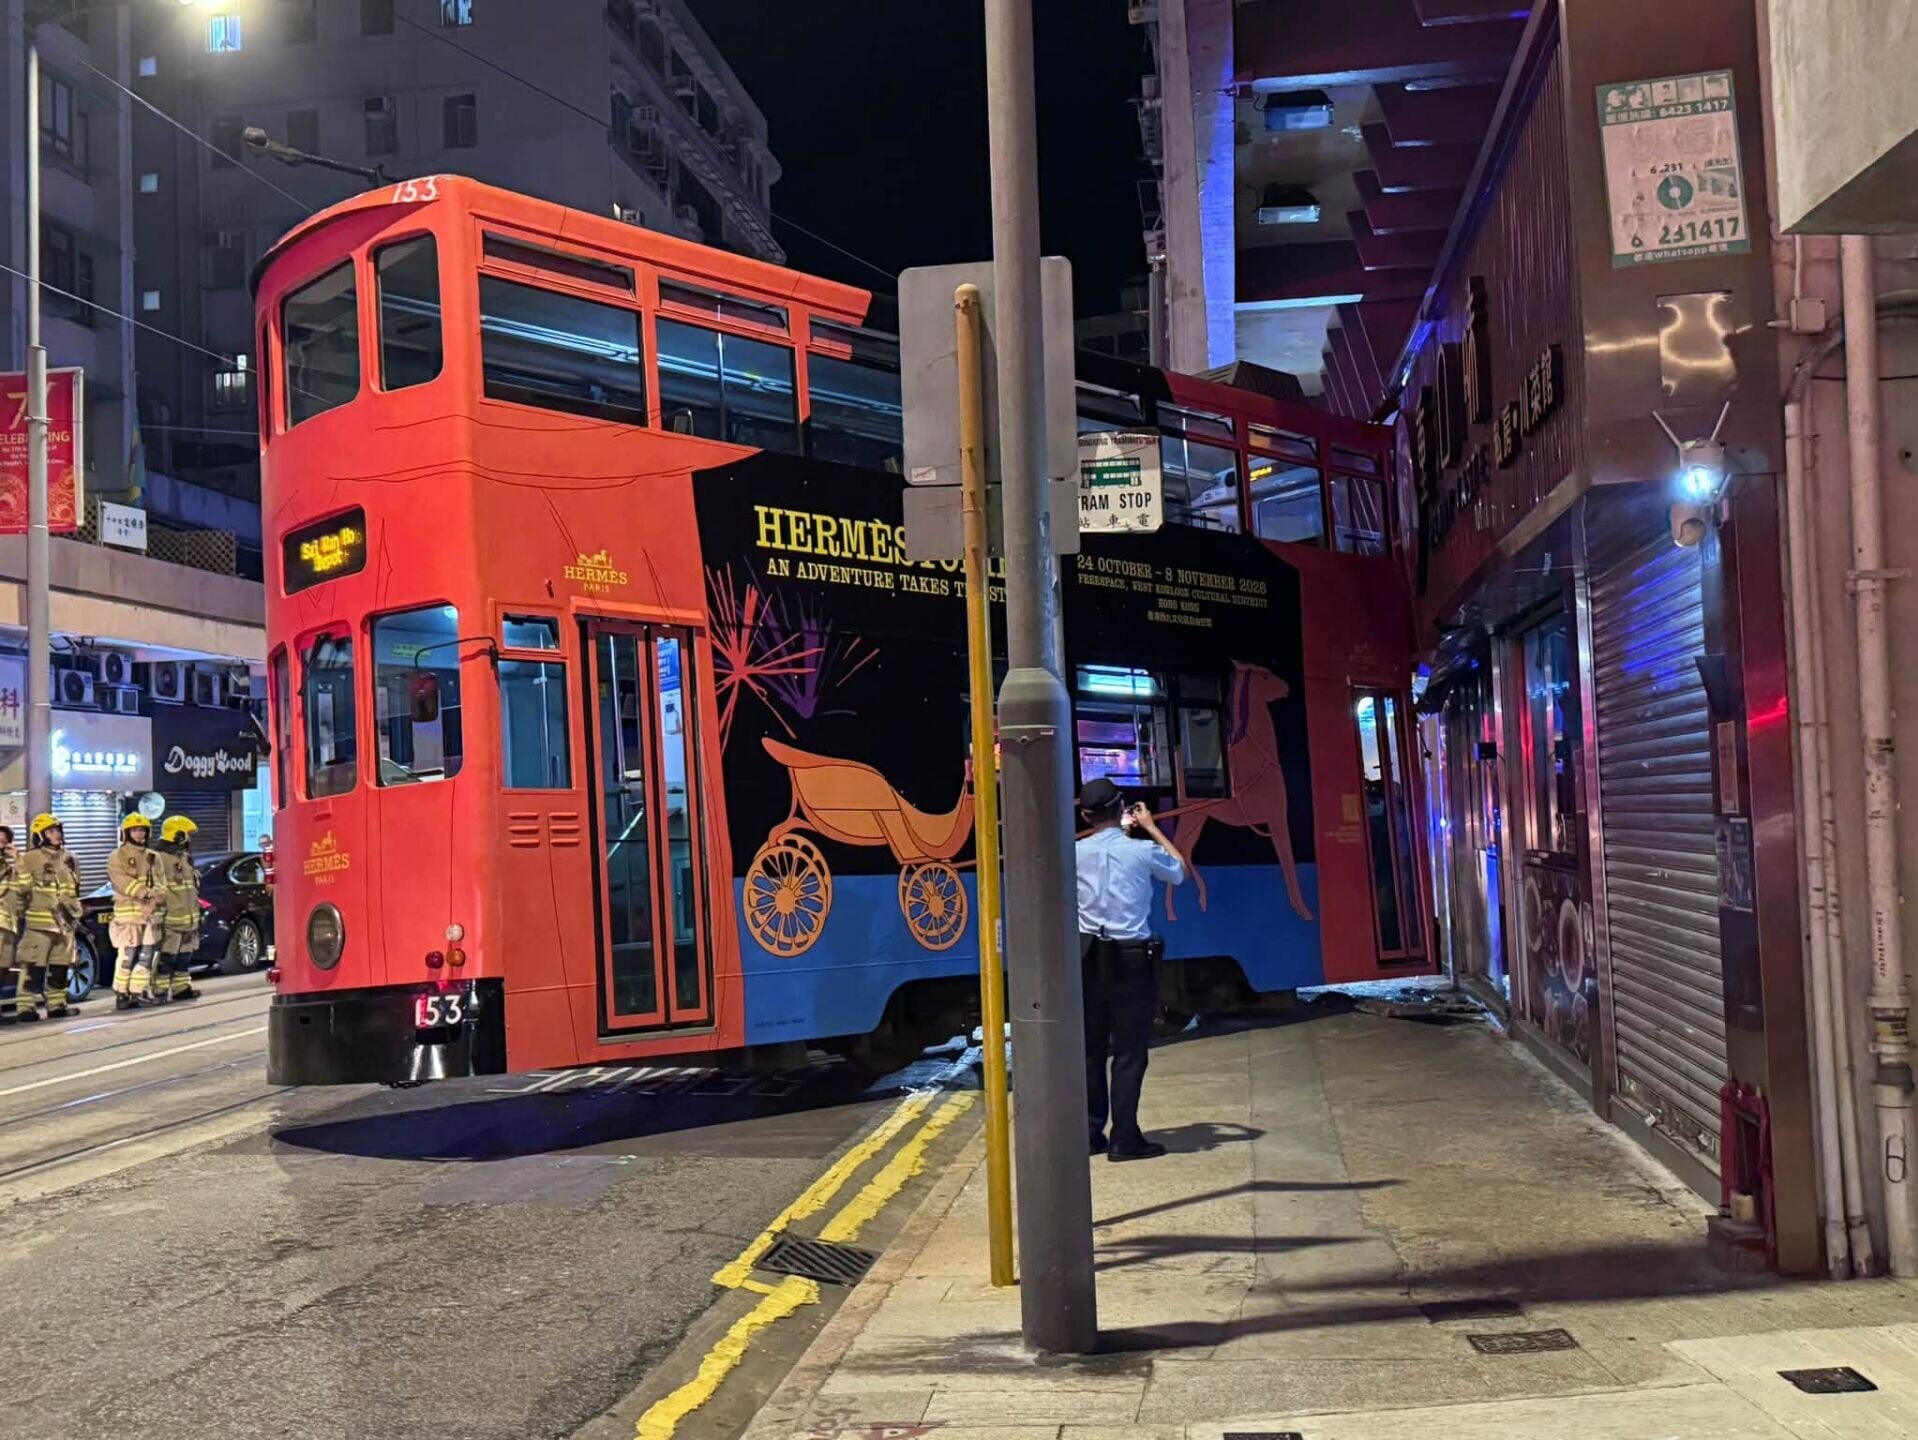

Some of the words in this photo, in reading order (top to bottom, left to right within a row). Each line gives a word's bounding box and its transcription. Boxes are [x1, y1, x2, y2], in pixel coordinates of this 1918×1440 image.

[392, 177, 438, 204] 153
[1078, 494, 1109, 511] RAM
[1119, 492, 1152, 509] STOP
[766, 557, 790, 577] AN
[796, 562, 895, 589] ADVENTURE
[899, 574, 949, 596] TAKES
[1076, 554, 1094, 571] 24
[1097, 557, 1153, 579] OCTOBER
[1177, 569, 1236, 591] NOVEMBER
[583, 583, 610, 593] PARIS
[414, 995, 462, 1026] 153
